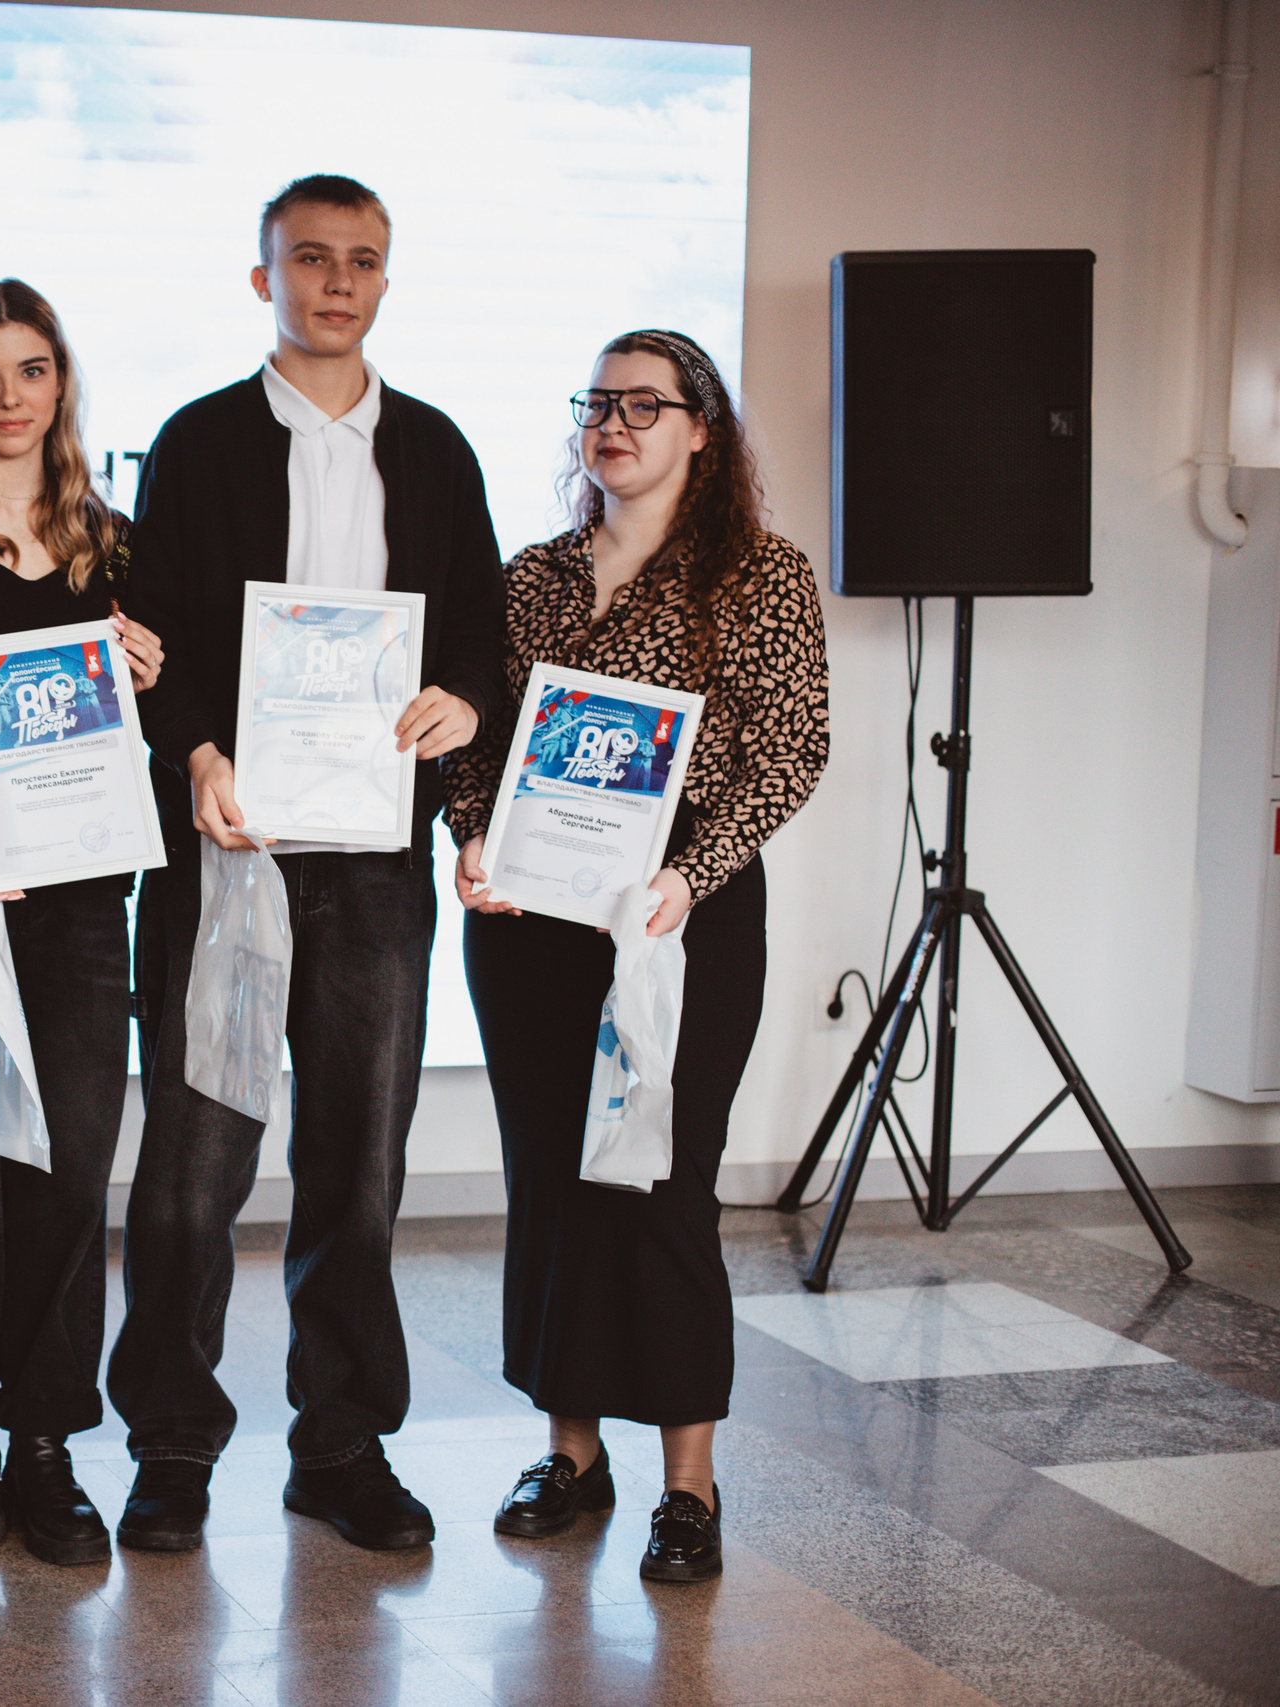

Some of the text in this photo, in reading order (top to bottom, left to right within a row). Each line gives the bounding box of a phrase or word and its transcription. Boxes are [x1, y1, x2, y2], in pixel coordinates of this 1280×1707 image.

[76, 738, 107, 748] ПИСЬМО
[333, 732, 366, 743] Сергею
[11, 764, 105, 786] Простенко Екатерине
[26, 775, 94, 791] Александровне
[536, 780, 642, 807] БЛАГОДАРСТВЕННОЕ ПИСЬМО
[548, 807, 622, 830] Абрамовой Арине
[561, 818, 604, 834] Сергеевне
